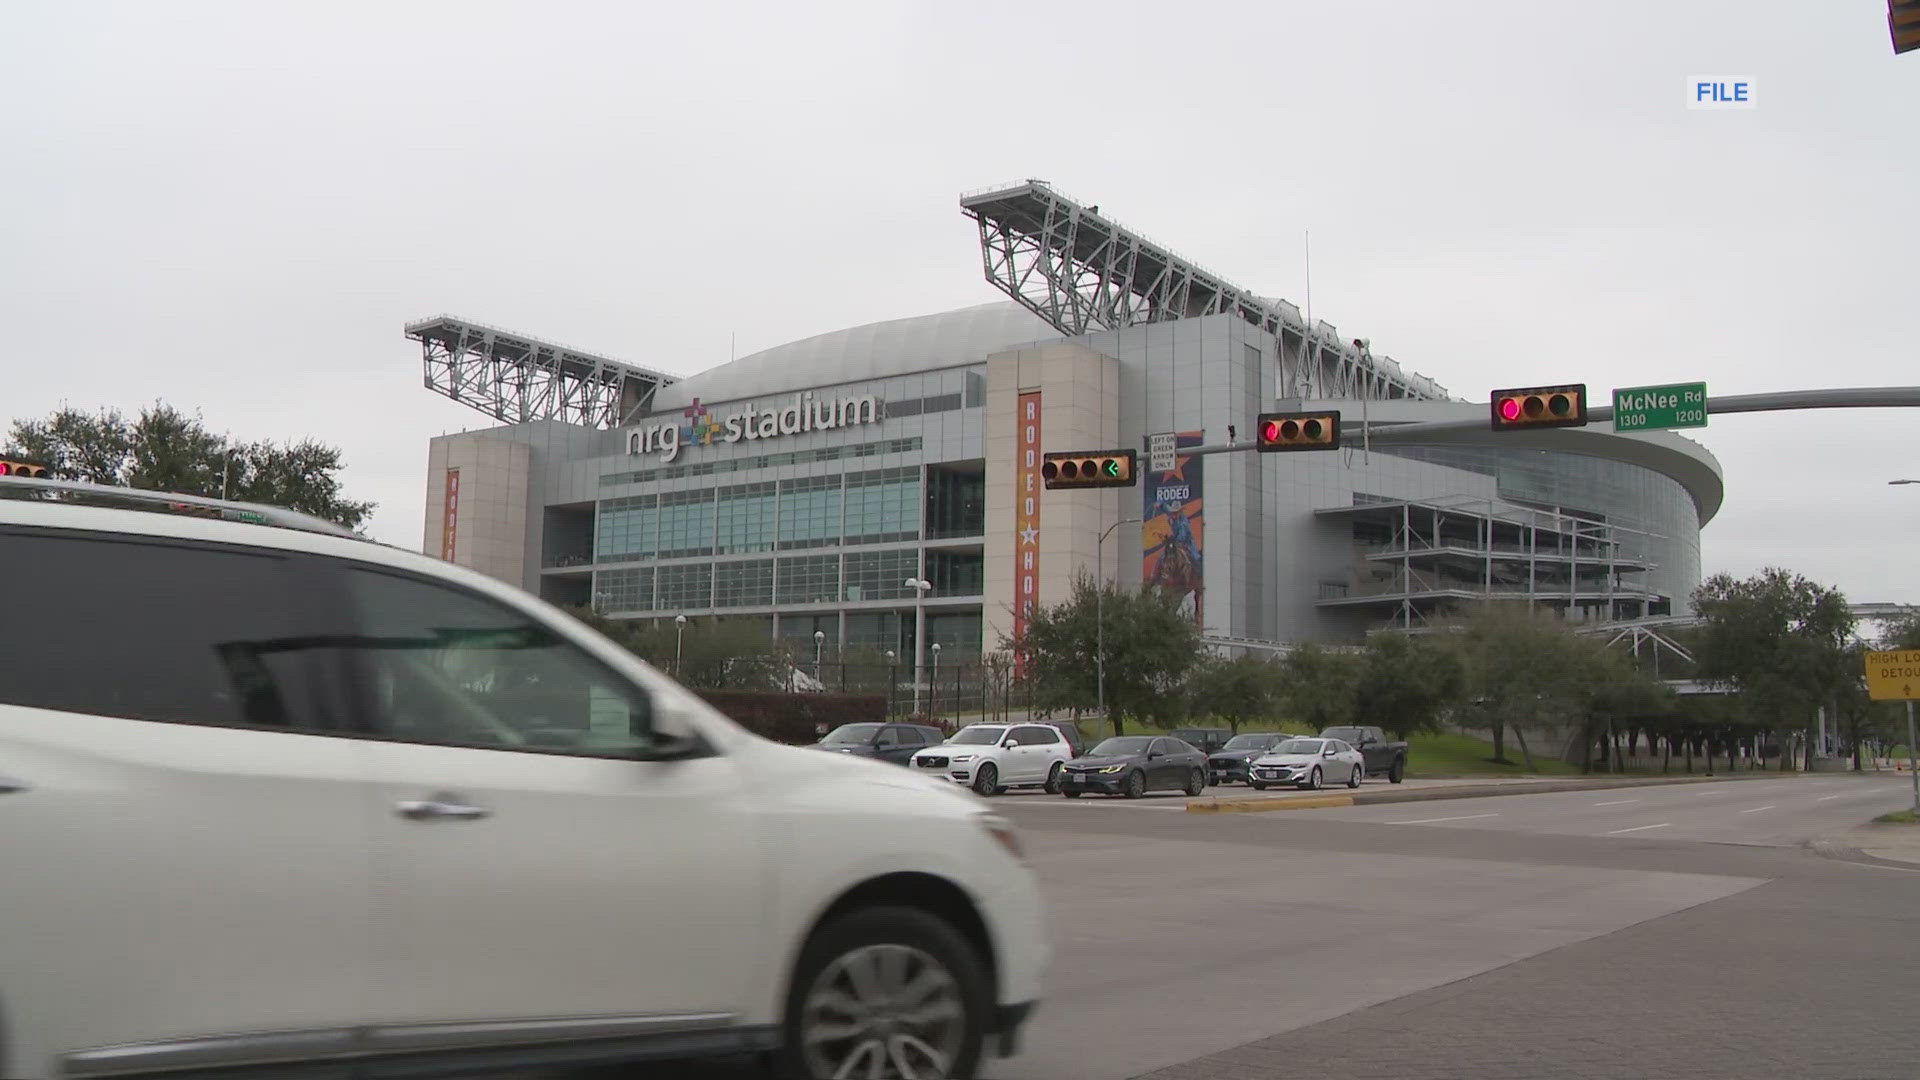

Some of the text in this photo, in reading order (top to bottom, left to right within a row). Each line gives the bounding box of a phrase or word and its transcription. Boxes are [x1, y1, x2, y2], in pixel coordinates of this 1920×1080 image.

[1619, 391, 1702, 411] McNee Rd
[1620, 410, 1702, 426] 1300 1200
[626, 391, 876, 463] nrg stadium
[1151, 435, 1175, 444] LEFT ON
[1153, 444, 1173, 452] GREEN
[1026, 402, 1035, 516] RODEO
[1156, 487, 1190, 500] RODEO
[1870, 653, 1899, 664] HIGH
